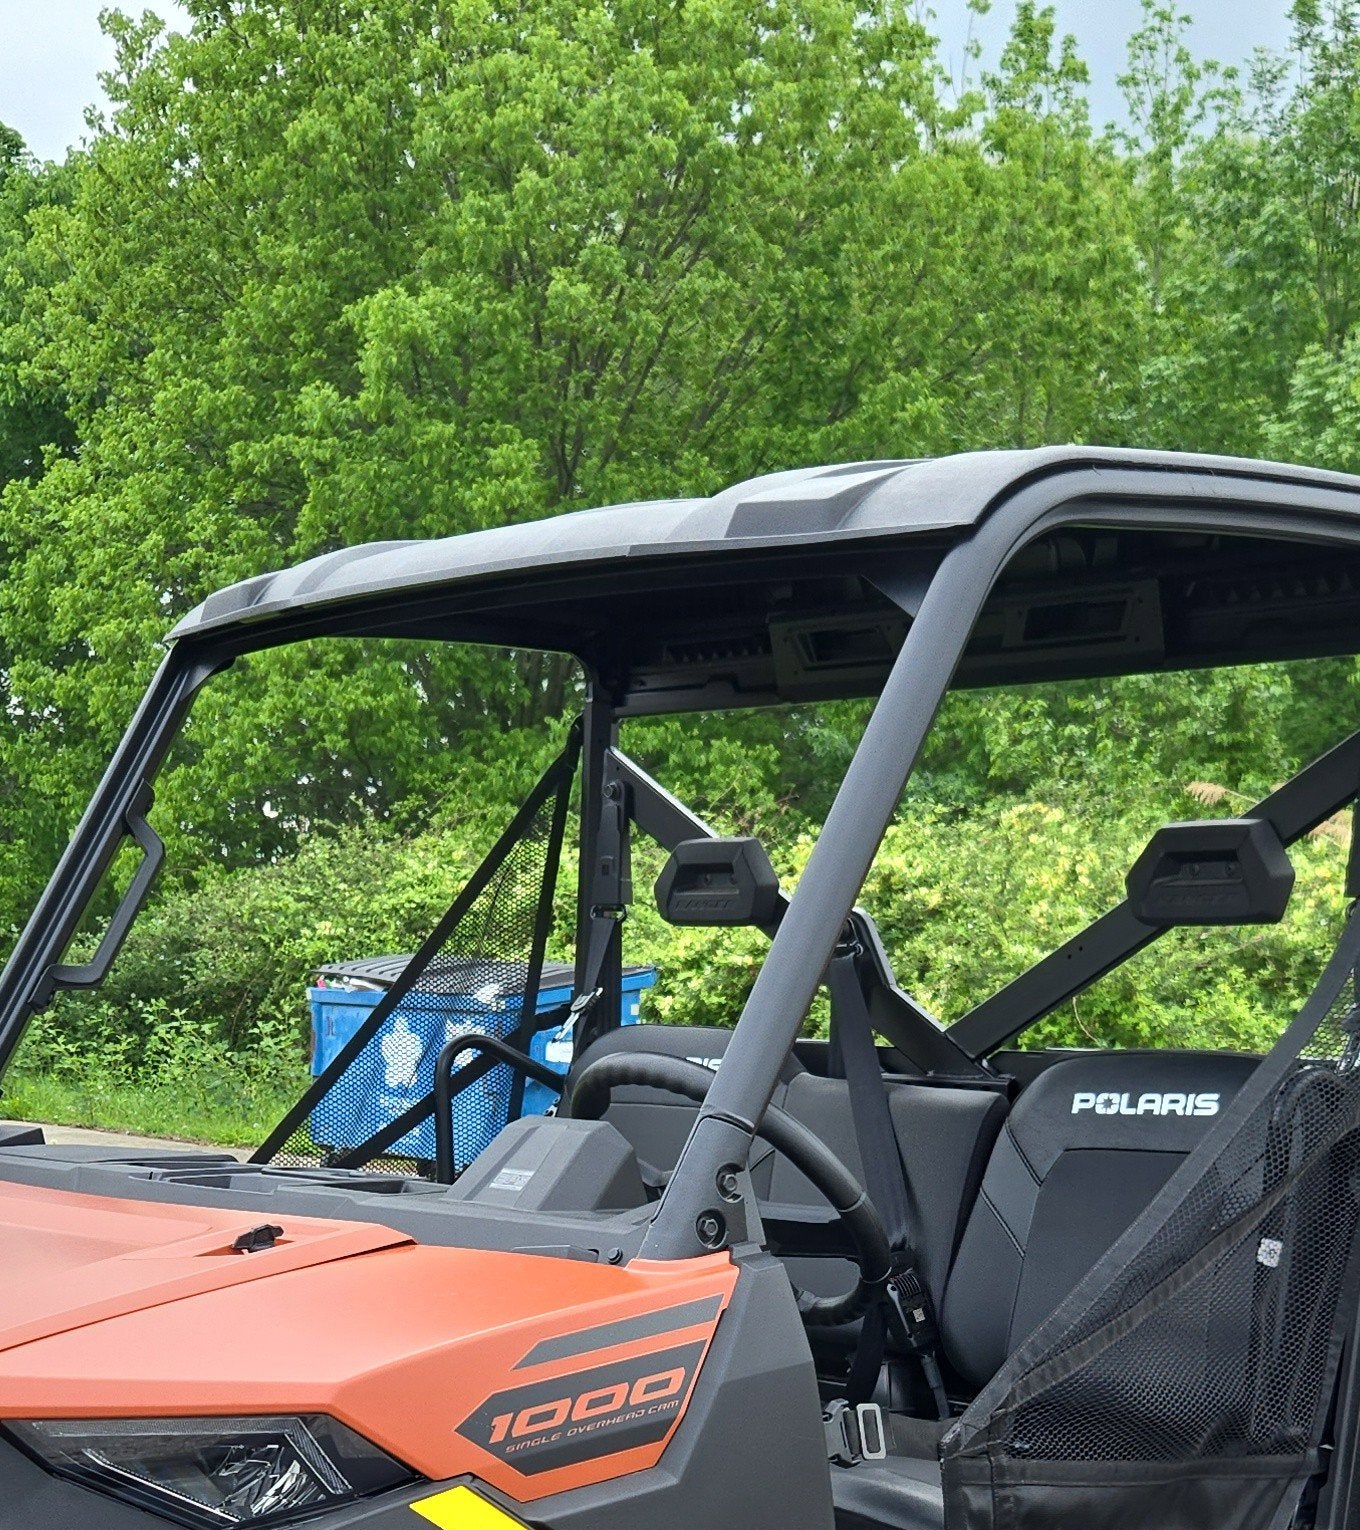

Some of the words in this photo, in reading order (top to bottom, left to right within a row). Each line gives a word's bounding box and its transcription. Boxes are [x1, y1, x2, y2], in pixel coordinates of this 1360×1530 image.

[1071, 1092, 1221, 1117] POLARIS
[489, 1367, 686, 1443] 1000
[504, 1431, 563, 1453] SINGLE
[566, 1409, 645, 1437] OVERHEAD
[647, 1400, 680, 1414] CAM
